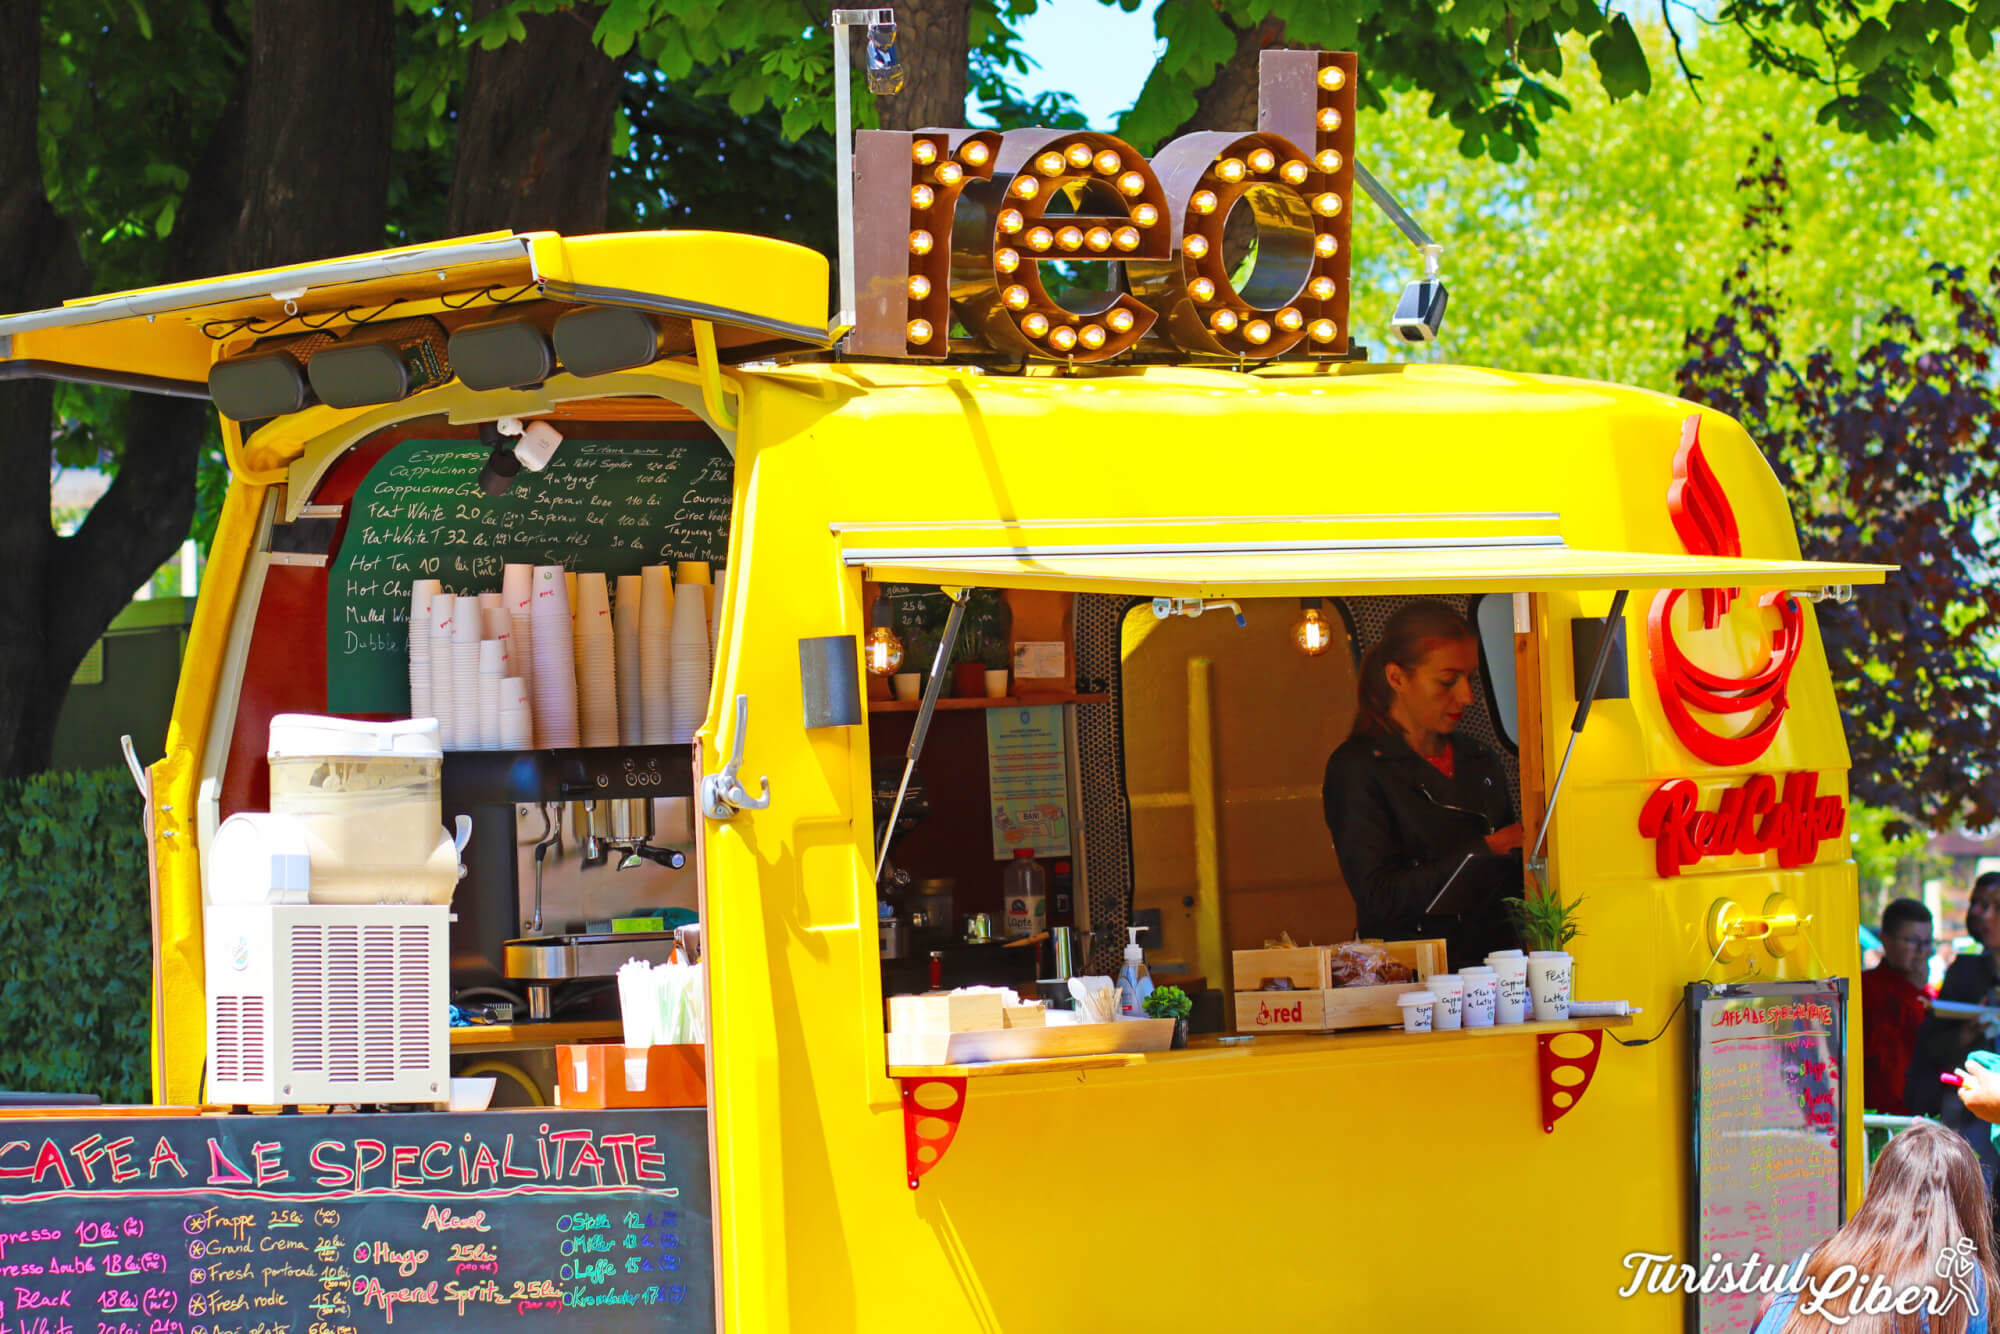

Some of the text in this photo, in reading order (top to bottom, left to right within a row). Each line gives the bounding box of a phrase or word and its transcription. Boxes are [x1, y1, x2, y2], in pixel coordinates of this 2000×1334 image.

[853, 47, 1358, 363] red
[456, 504, 481, 519] 20
[444, 529, 469, 545] 32
[350, 554, 382, 572] Hot
[420, 557, 440, 574] 10
[346, 579, 379, 597] Hot
[346, 606, 385, 624] Mulled
[1274, 1001, 1302, 1023] red
[0, 1134, 189, 1188] CAFEA
[204, 1206, 257, 1241] Frappe
[206, 1237, 254, 1255] Grand
[260, 1237, 309, 1251] Crema
[373, 1241, 429, 1276] Hugo
[208, 1262, 254, 1281] Fresh
[14, 1287, 72, 1310] Black
[207, 1290, 249, 1315] Fresh
[364, 1277, 439, 1324] Aperol
[444, 1280, 513, 1316] Spritz
